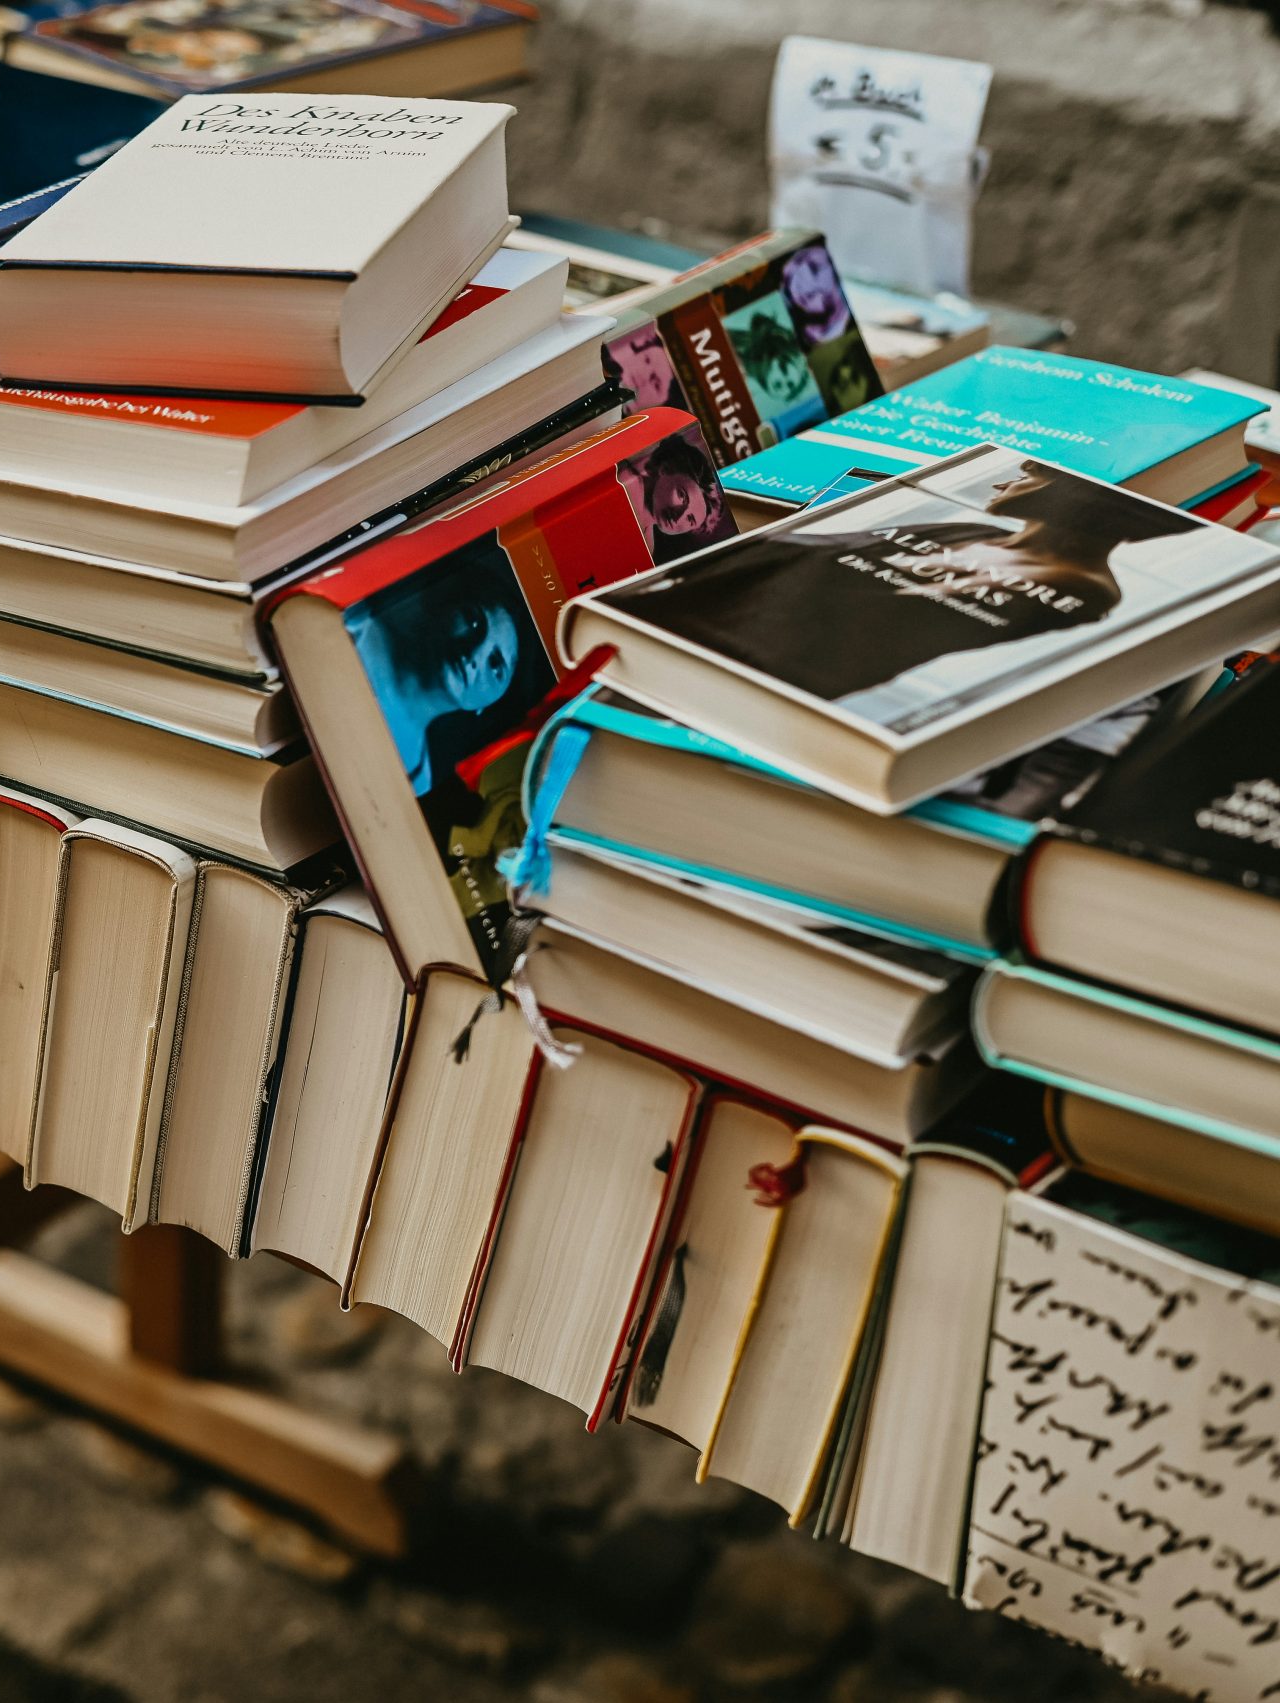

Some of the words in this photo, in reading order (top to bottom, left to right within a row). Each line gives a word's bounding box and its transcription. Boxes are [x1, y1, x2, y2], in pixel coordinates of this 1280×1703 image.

[180, 118, 444, 140] Wunderhorn
[194, 103, 280, 118] Des
[282, 104, 464, 125] Knaben
[1087, 372, 1193, 404] Scholem
[858, 403, 903, 421] Die
[909, 414, 1042, 450] Geschichte
[975, 409, 1095, 446] Benjamin
